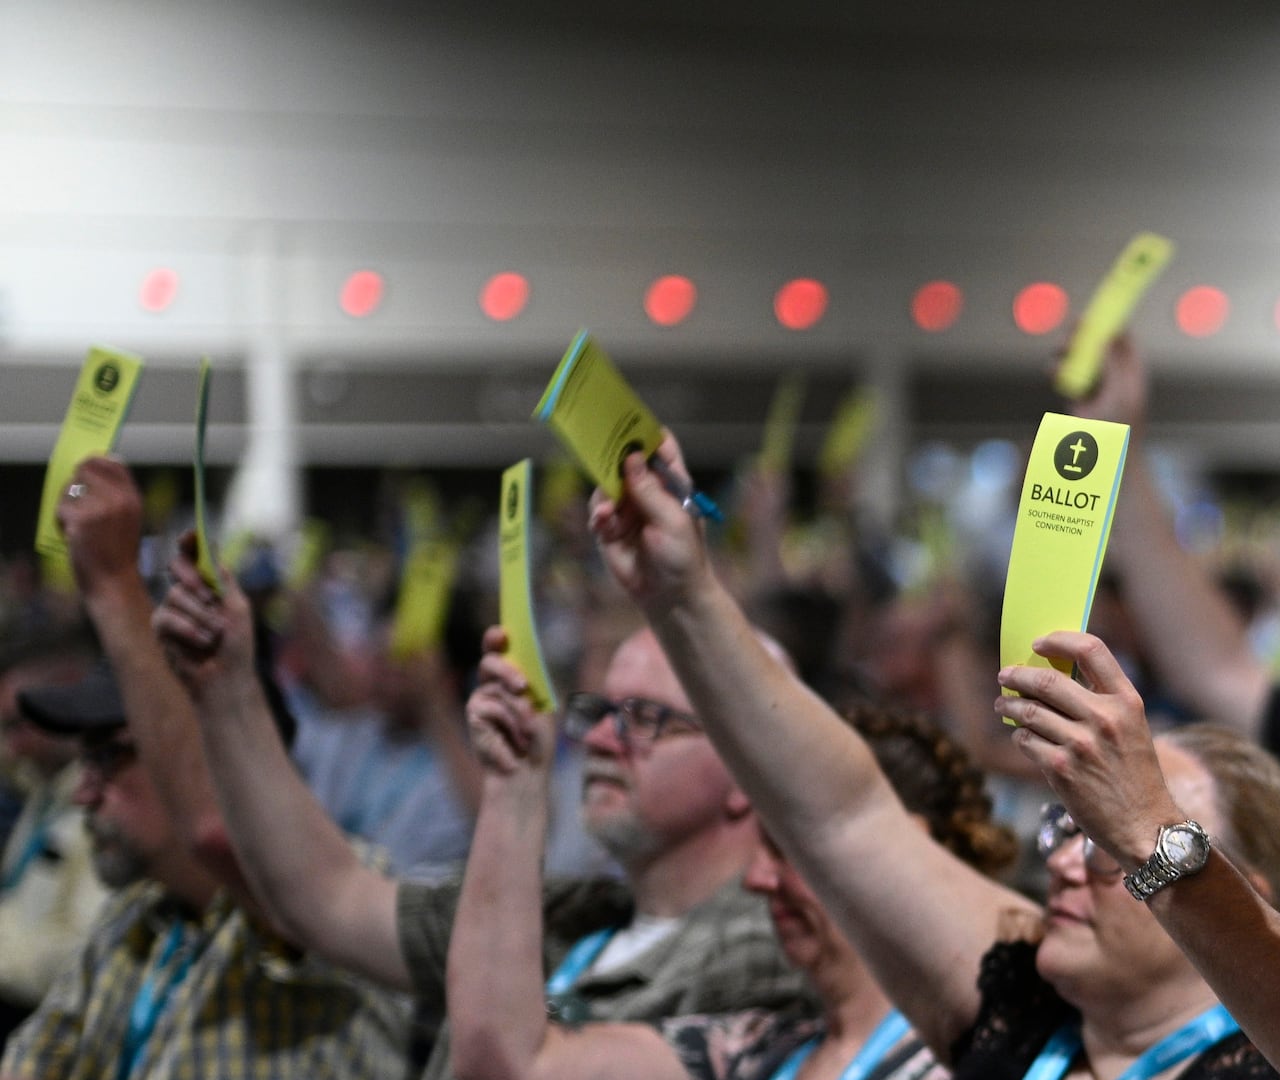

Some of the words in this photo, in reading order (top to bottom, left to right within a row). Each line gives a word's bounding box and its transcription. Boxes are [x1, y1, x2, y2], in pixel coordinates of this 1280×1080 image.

[1031, 484, 1100, 511] BALLOT
[1028, 509, 1066, 523] SOUTHERN
[1066, 516, 1094, 527] BAPTIST
[1035, 521, 1083, 536] CONVENTION
